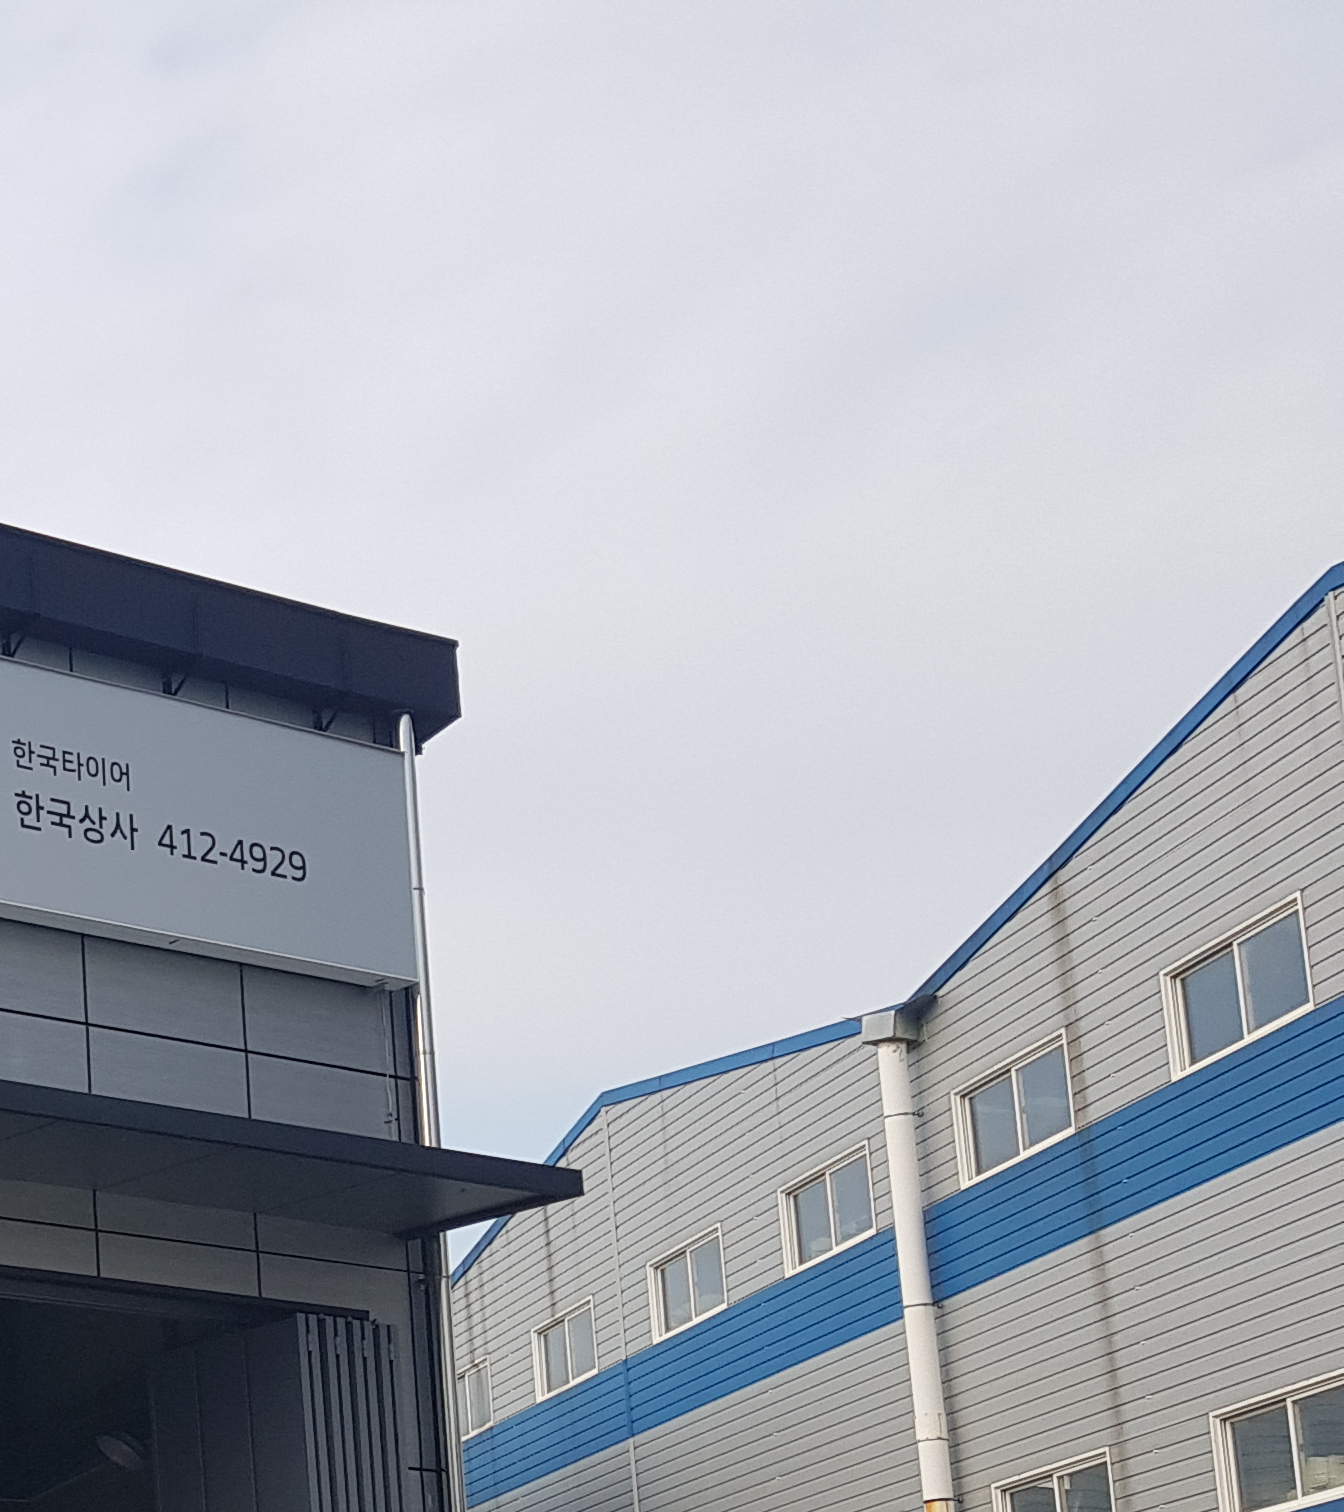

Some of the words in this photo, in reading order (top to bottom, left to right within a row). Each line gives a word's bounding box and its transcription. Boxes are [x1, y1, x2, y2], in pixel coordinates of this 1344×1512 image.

[11, 737, 132, 792] 한국타이어
[14, 790, 139, 850] 한국상사
[157, 824, 308, 882] 412-4929
